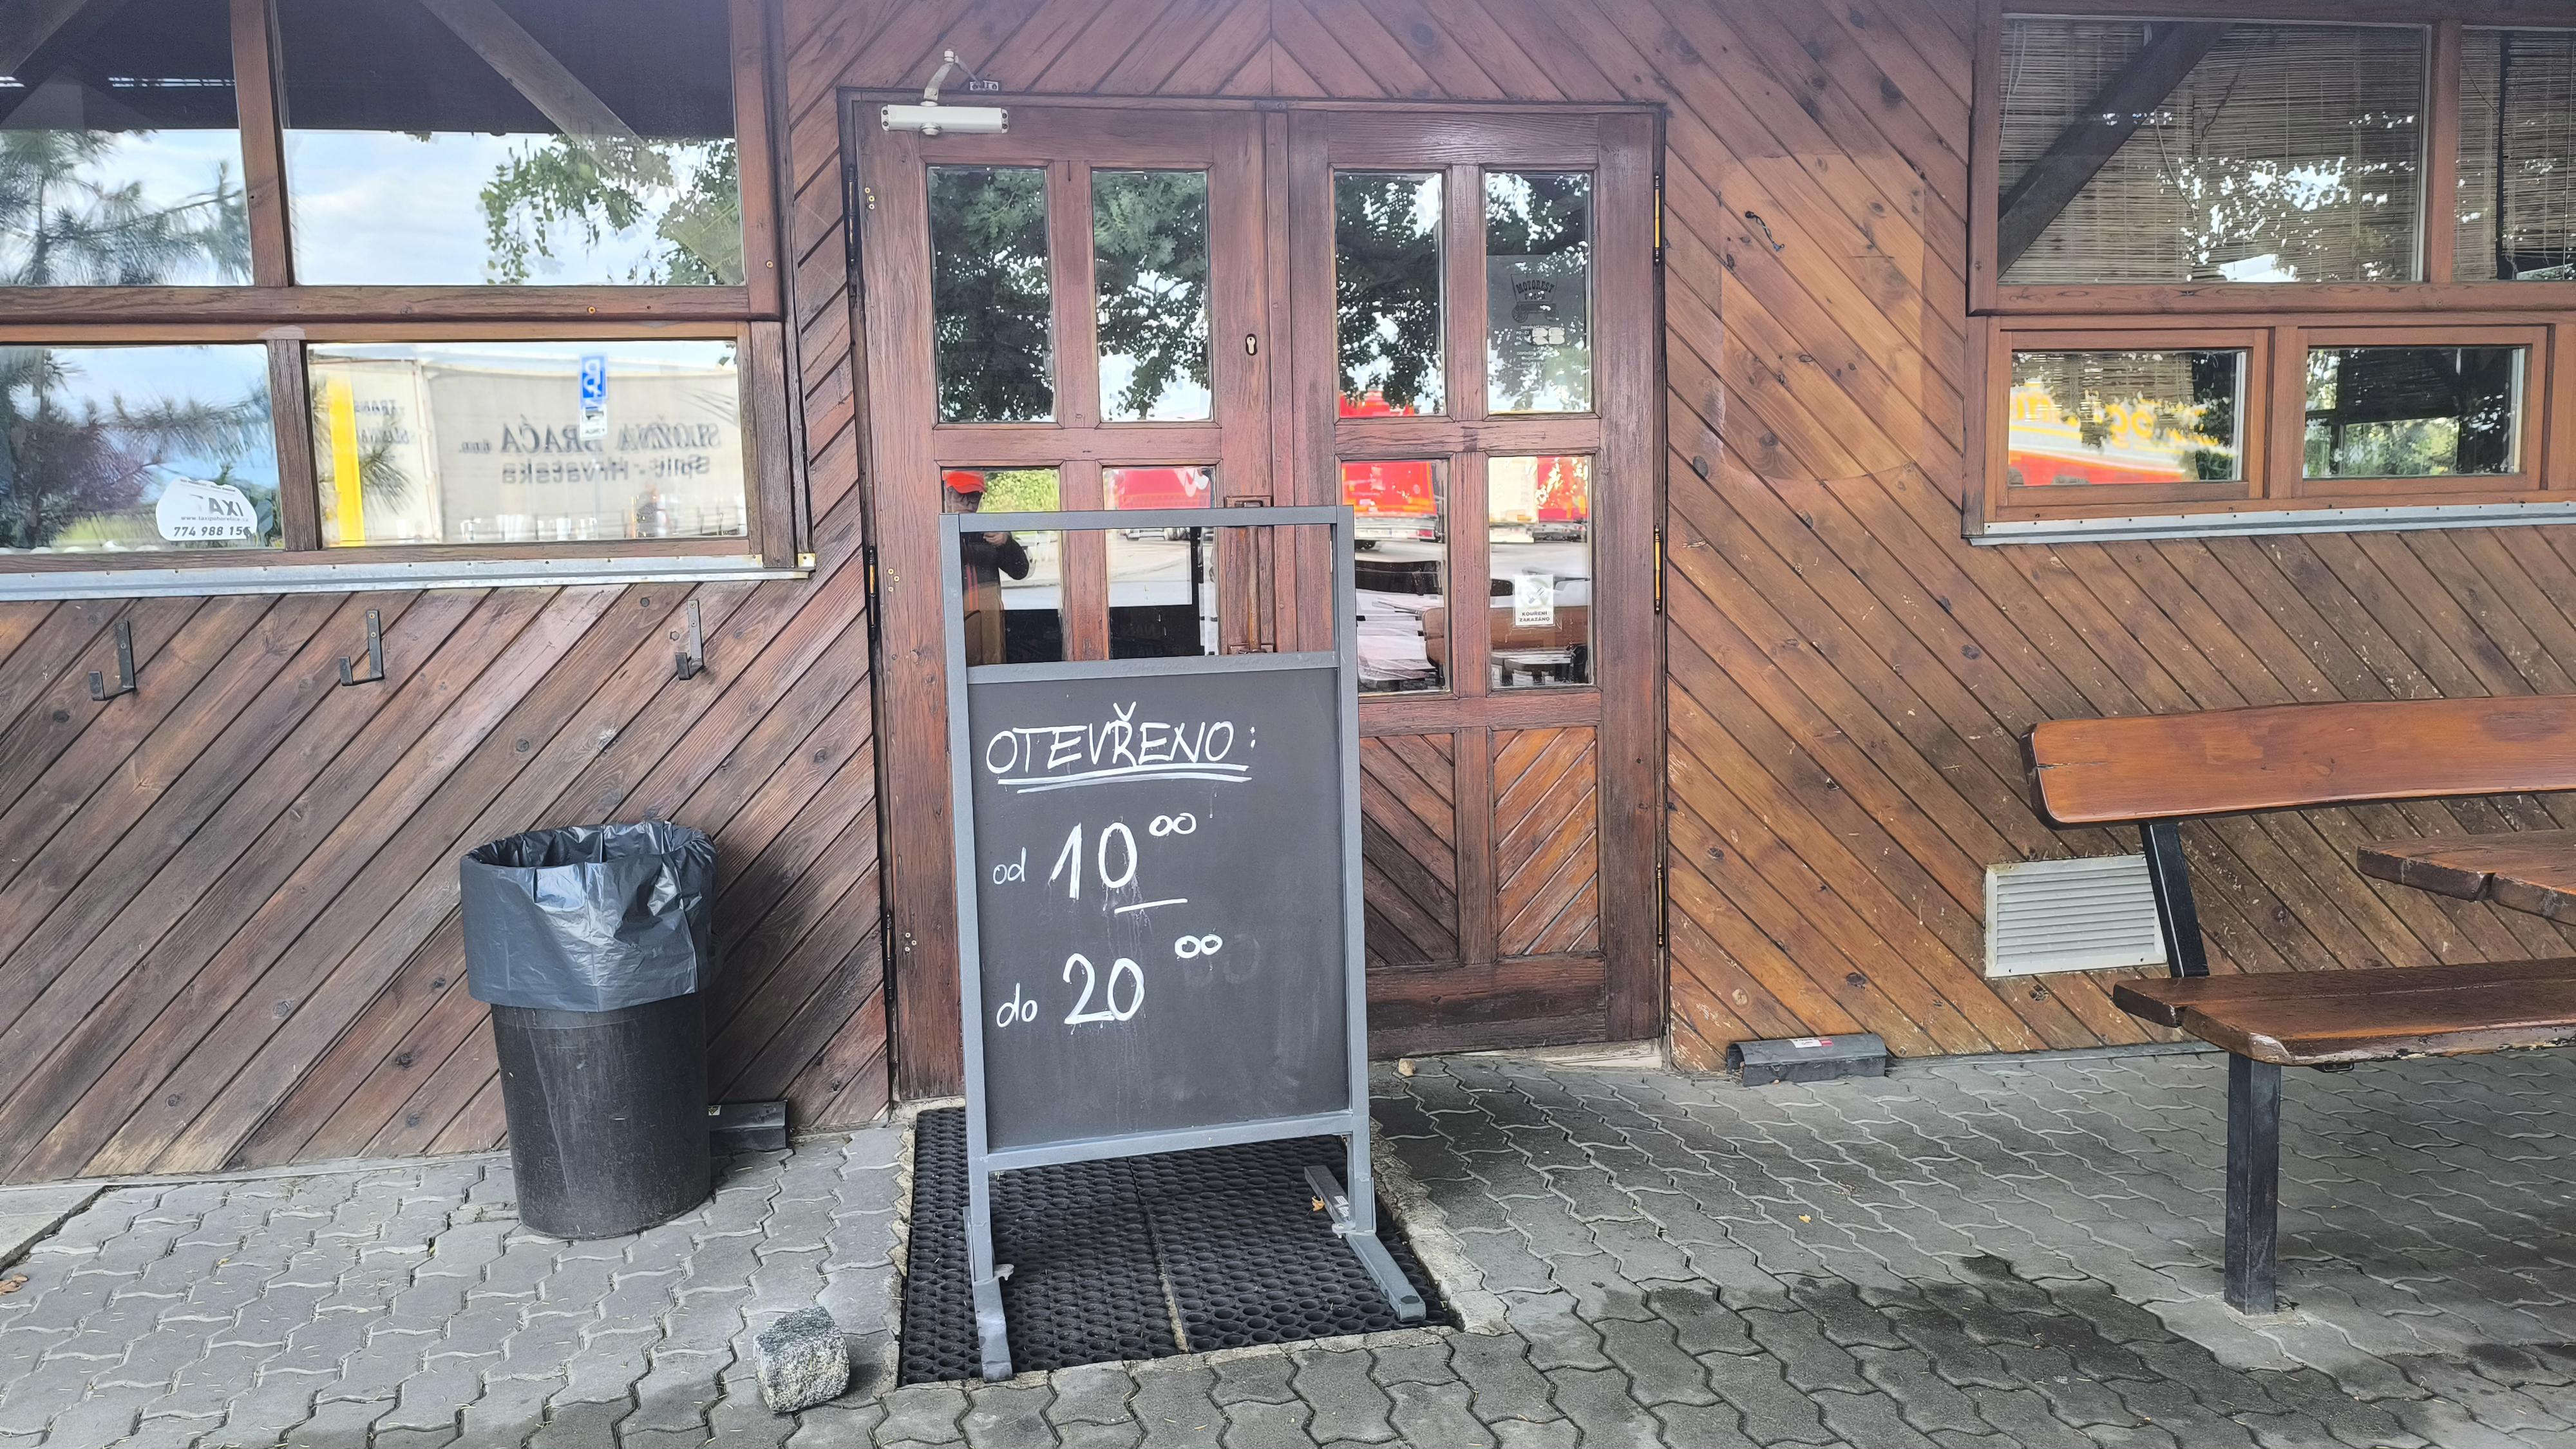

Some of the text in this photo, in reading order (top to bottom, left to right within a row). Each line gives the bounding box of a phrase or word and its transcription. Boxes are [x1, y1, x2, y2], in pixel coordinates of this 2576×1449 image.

[1516, 279, 1555, 294] MOTOREST
[174, 526, 196, 536] 774
[201, 526, 223, 536] 988
[986, 701, 1256, 774] OTEVŘENO:
[992, 847, 1027, 885] od
[997, 982, 1038, 1027] do
